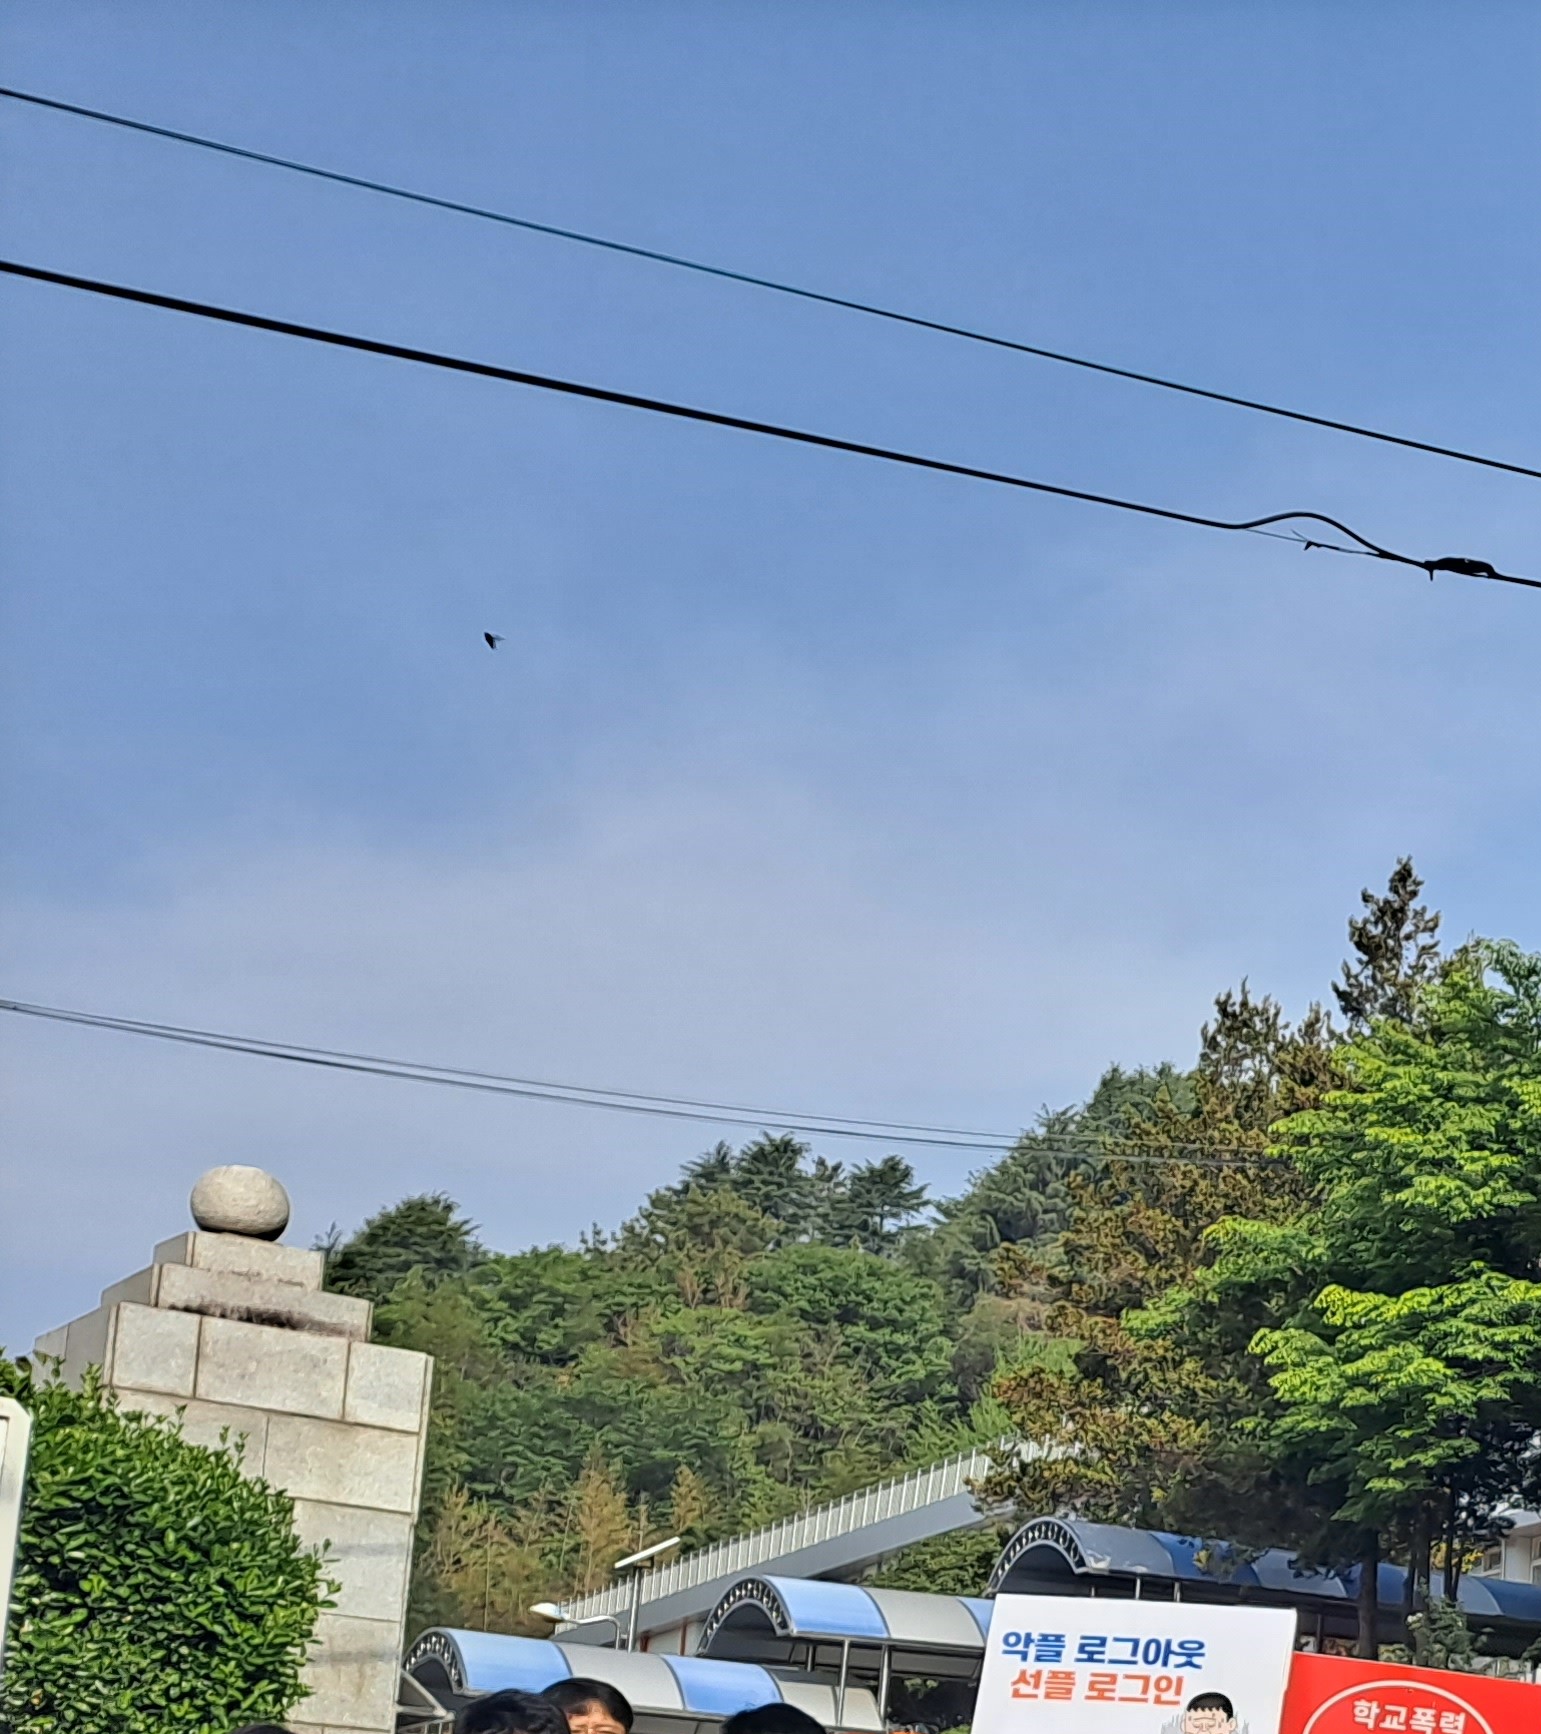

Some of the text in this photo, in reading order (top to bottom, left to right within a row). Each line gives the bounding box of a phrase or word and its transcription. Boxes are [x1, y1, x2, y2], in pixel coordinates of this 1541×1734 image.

[1001, 1632, 1206, 1672] 악플 로그아웃
[1010, 1669, 1184, 1705] 선플 로그인
